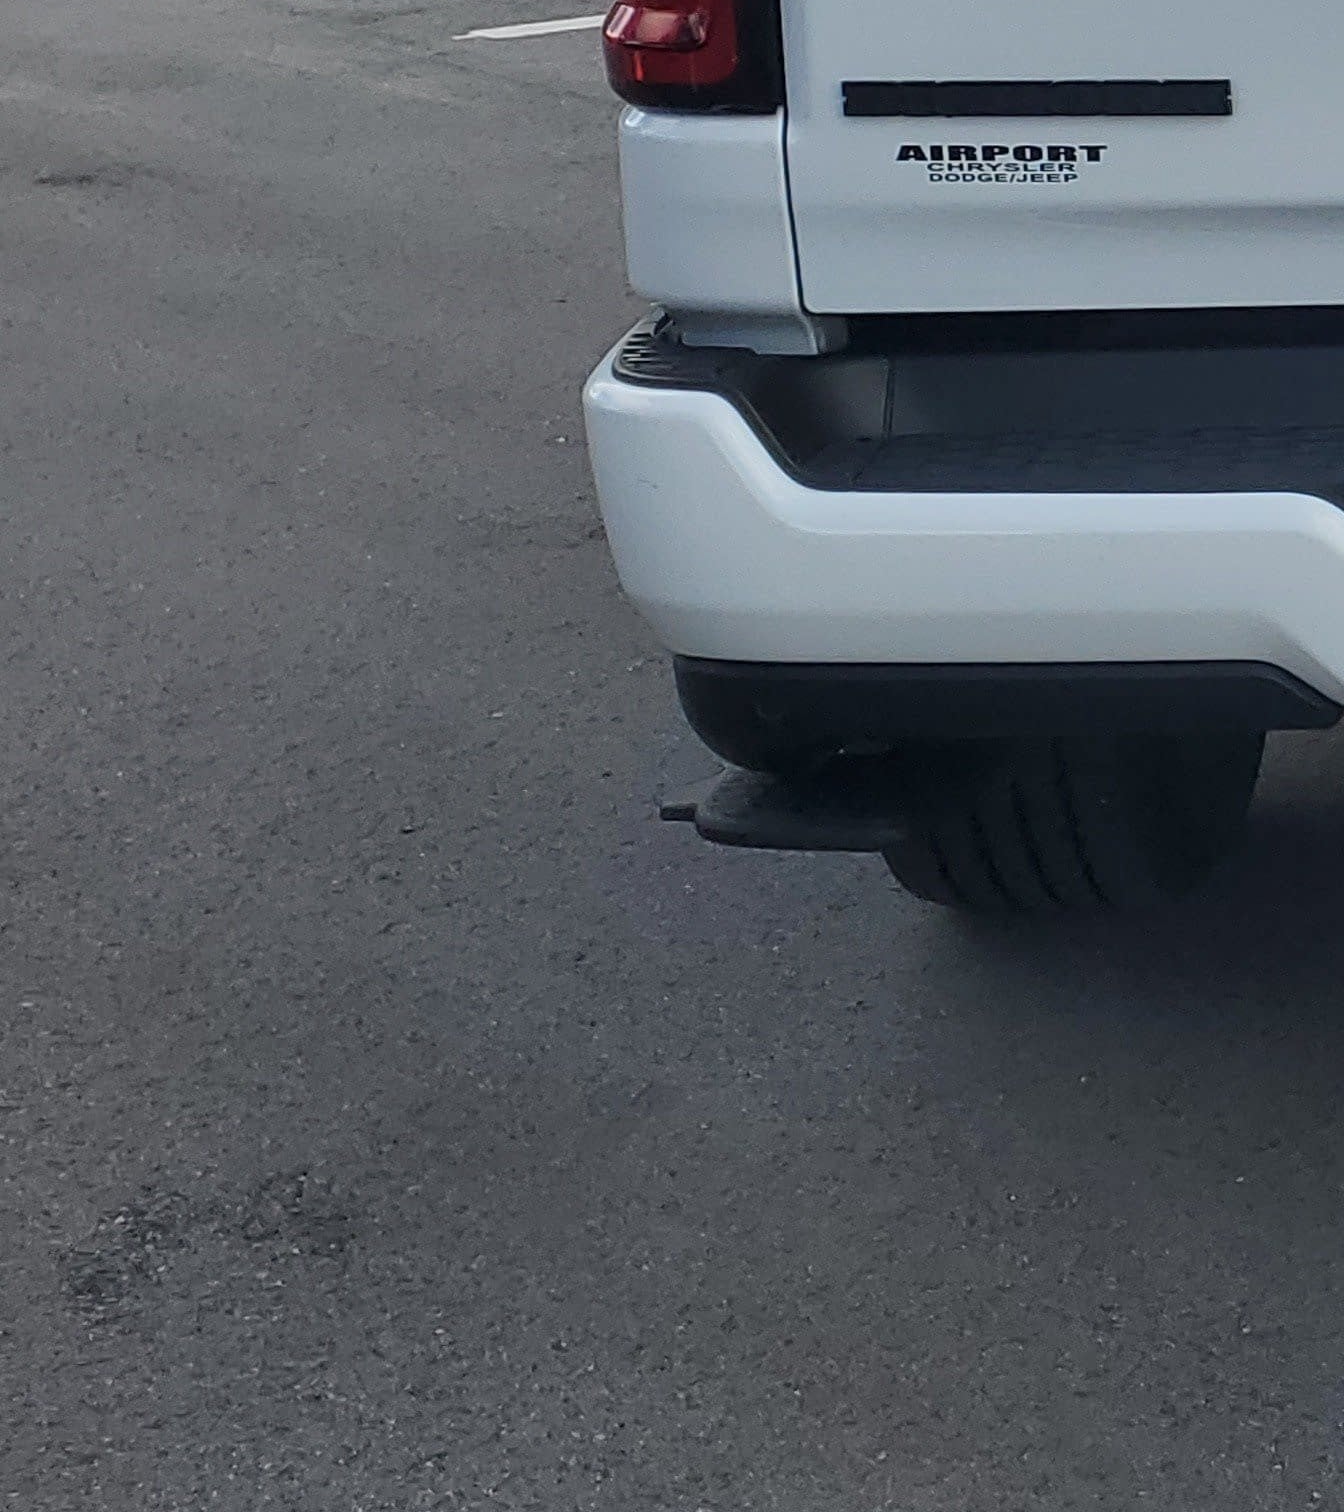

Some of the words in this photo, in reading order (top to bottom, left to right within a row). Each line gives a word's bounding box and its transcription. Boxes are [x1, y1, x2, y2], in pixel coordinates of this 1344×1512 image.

[896, 144, 1108, 162] AIRPORT
[926, 162, 1076, 172] CHRYSLER
[929, 173, 1079, 183] DODGE/JEEP
